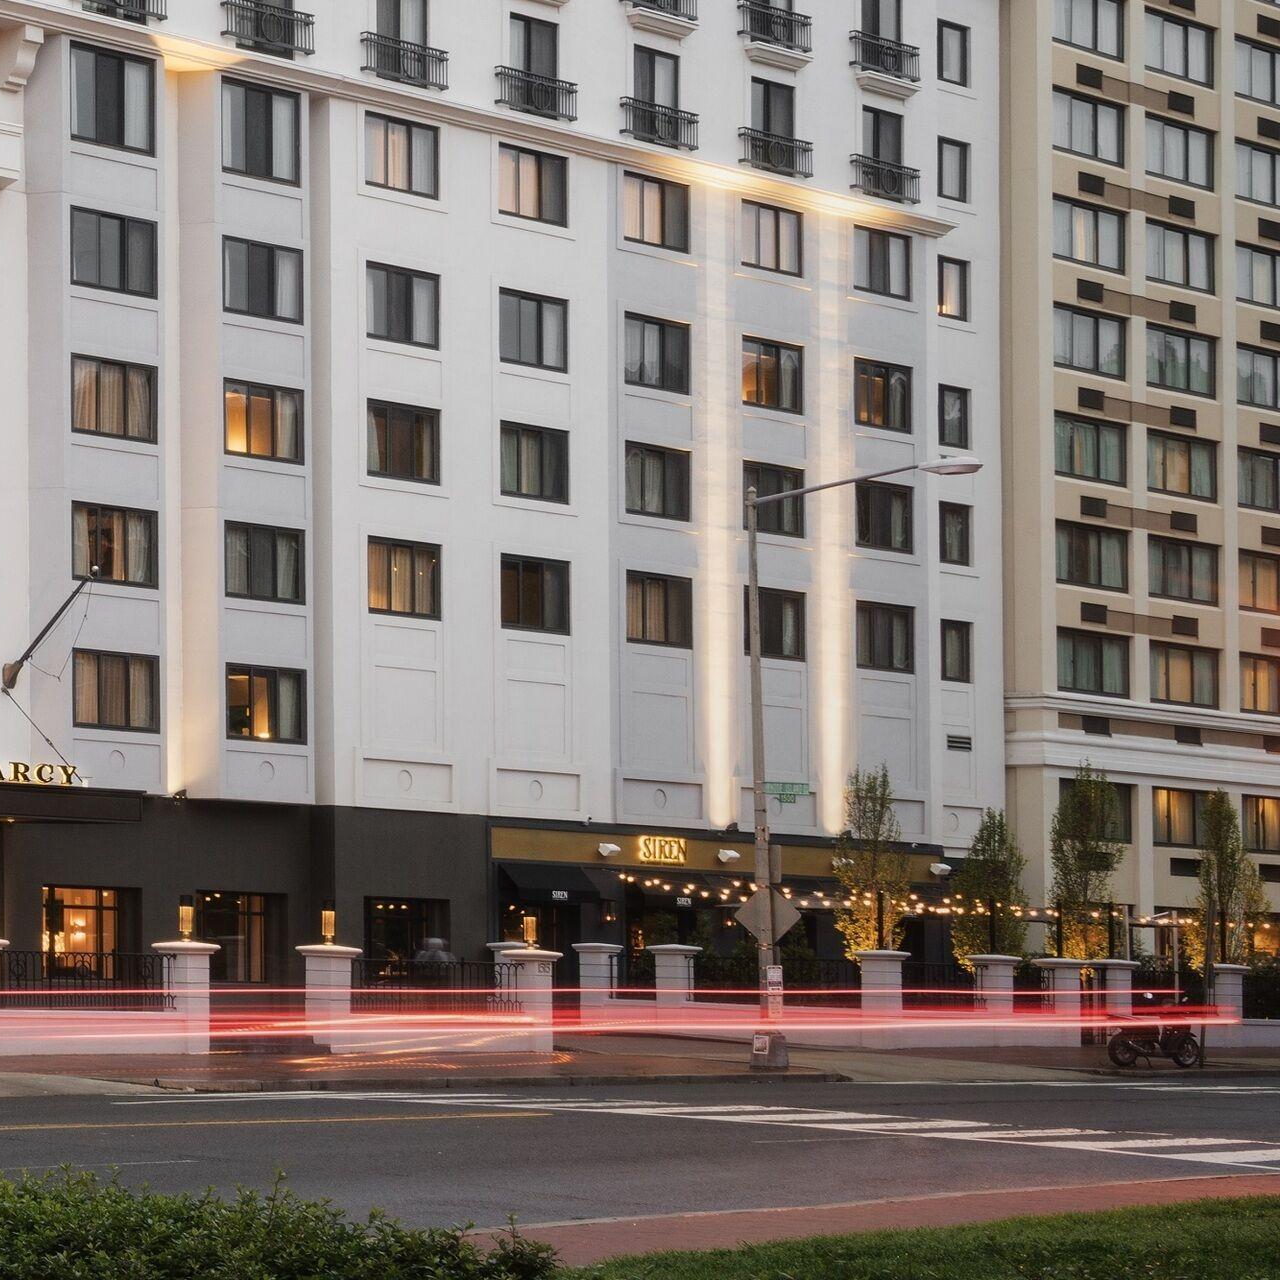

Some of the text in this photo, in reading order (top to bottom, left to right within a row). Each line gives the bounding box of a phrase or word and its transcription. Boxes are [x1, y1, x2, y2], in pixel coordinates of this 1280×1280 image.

[642, 837, 688, 861] SIREN
[552, 890, 568, 898] SIREN
[676, 897, 691, 905] SIREN
